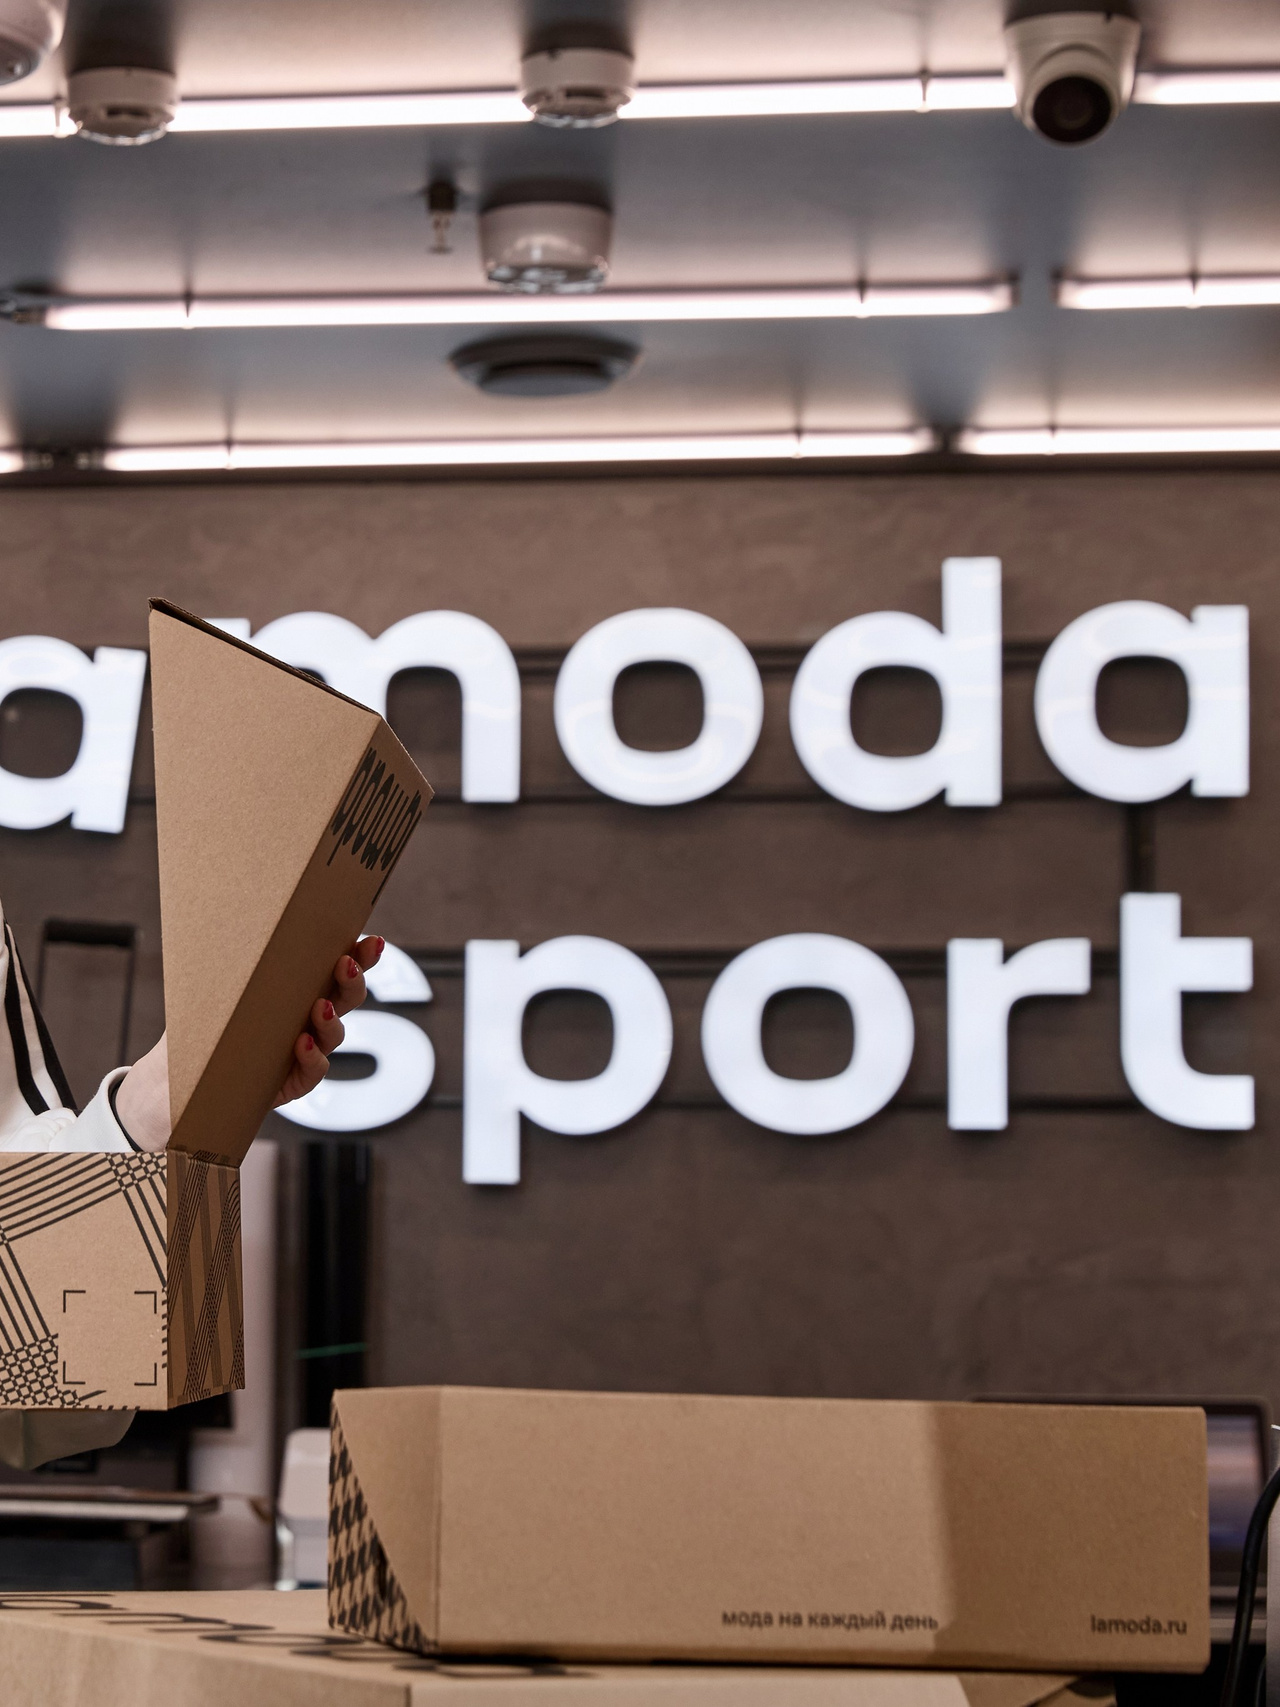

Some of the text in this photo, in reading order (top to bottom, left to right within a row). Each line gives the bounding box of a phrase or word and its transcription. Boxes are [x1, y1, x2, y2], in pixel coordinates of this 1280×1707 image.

[272, 893, 1255, 1186] sport
[722, 1609, 938, 1633] мода на каждый день
[1090, 1614, 1187, 1636] lamoda.ru
